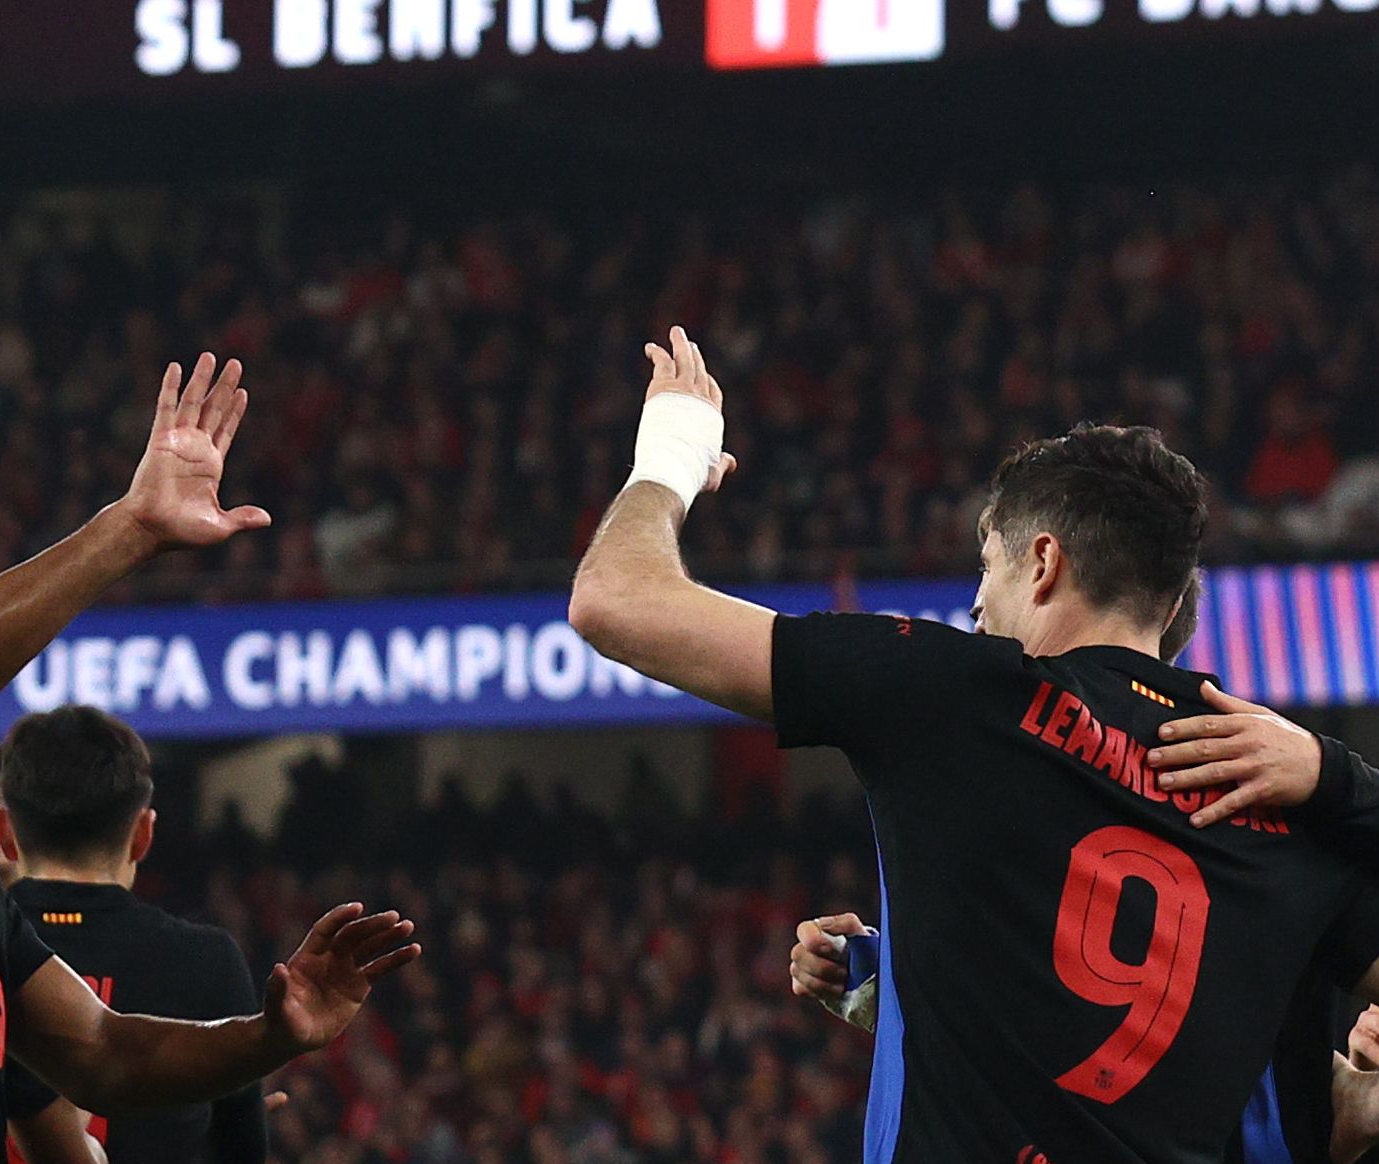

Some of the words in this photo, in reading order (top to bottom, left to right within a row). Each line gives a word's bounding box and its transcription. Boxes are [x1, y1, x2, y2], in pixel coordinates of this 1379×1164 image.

[135, 0, 240, 75] SL
[14, 635, 211, 713] UEFA
[222, 620, 684, 710] CHAMPIO
[1053, 826, 1210, 1104] 9
